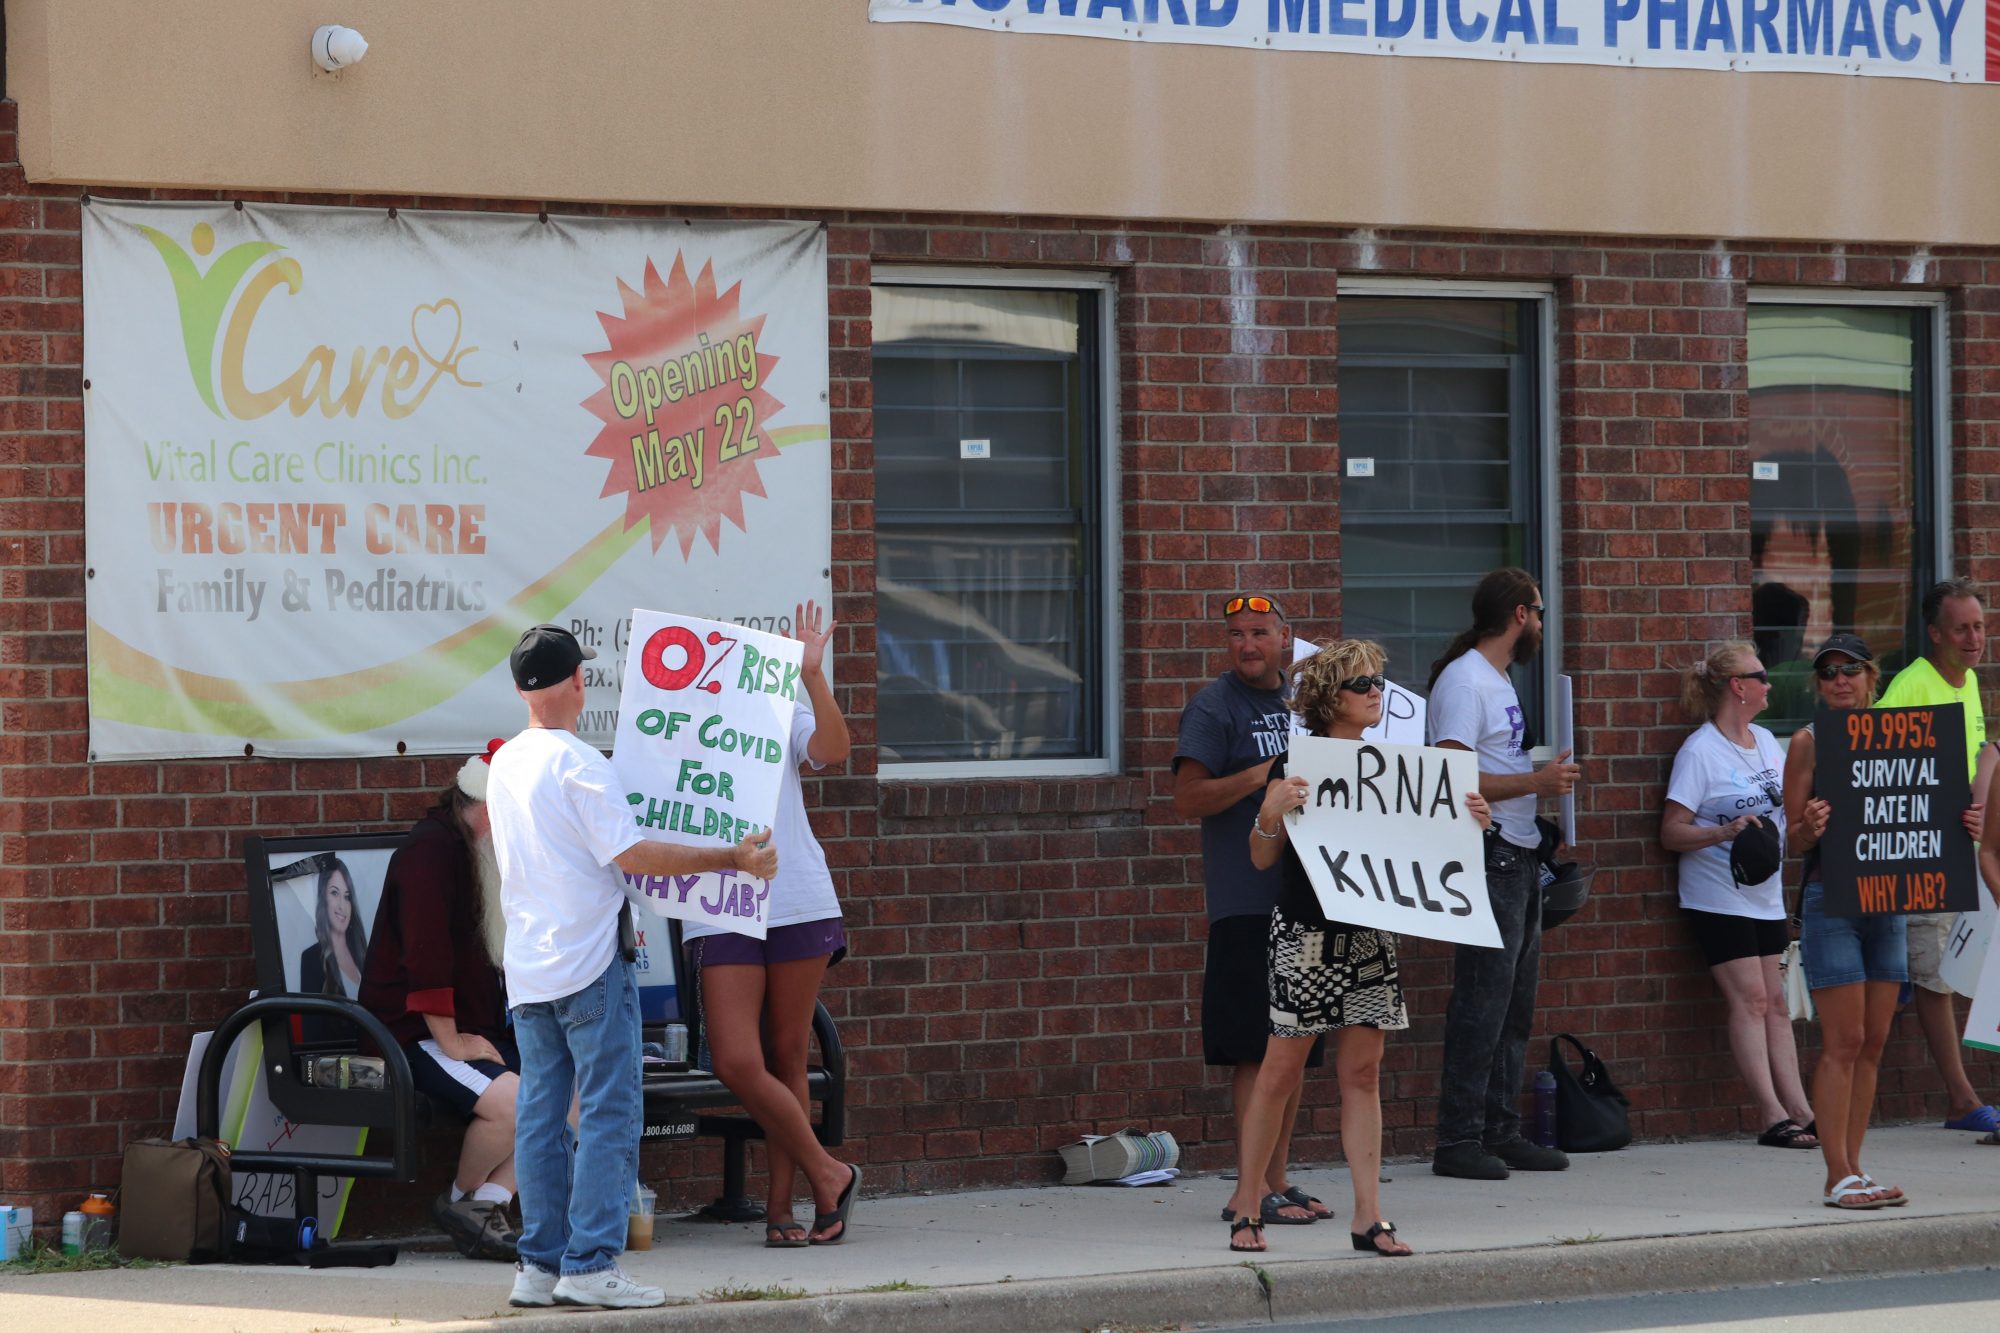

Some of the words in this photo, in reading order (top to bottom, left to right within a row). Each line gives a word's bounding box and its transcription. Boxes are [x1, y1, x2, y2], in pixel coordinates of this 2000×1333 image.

[1604, 0, 1966, 66] PHARMACY
[610, 330, 759, 425] Opening
[144, 440, 216, 483] Vital
[227, 441, 305, 483] Care
[314, 443, 421, 485] Clinics
[433, 444, 488, 485] Inc.
[631, 428, 705, 493] May
[714, 396, 761, 463] 22
[147, 502, 346, 554] URGENT
[365, 503, 487, 555] CARE
[156, 568, 266, 622] Family
[282, 568, 311, 612] &
[325, 568, 487, 613] Pediatrics
[737, 643, 801, 701] RISK
[636, 708, 691, 740] OF
[1847, 711, 1936, 751] 99.995%
[676, 759, 735, 802] FOR
[1317, 745, 1458, 820] mRNA
[1851, 757, 1939, 788] SURVIVAL
[1863, 796, 1906, 825] RATE
[1911, 795, 1929, 822] IN
[1855, 830, 1942, 861] CHILDREN
[701, 868, 770, 922] JAB?
[1318, 844, 1473, 917] KILLS
[1857, 874, 1897, 913] WHY
[1903, 871, 1946, 911] JAB?
